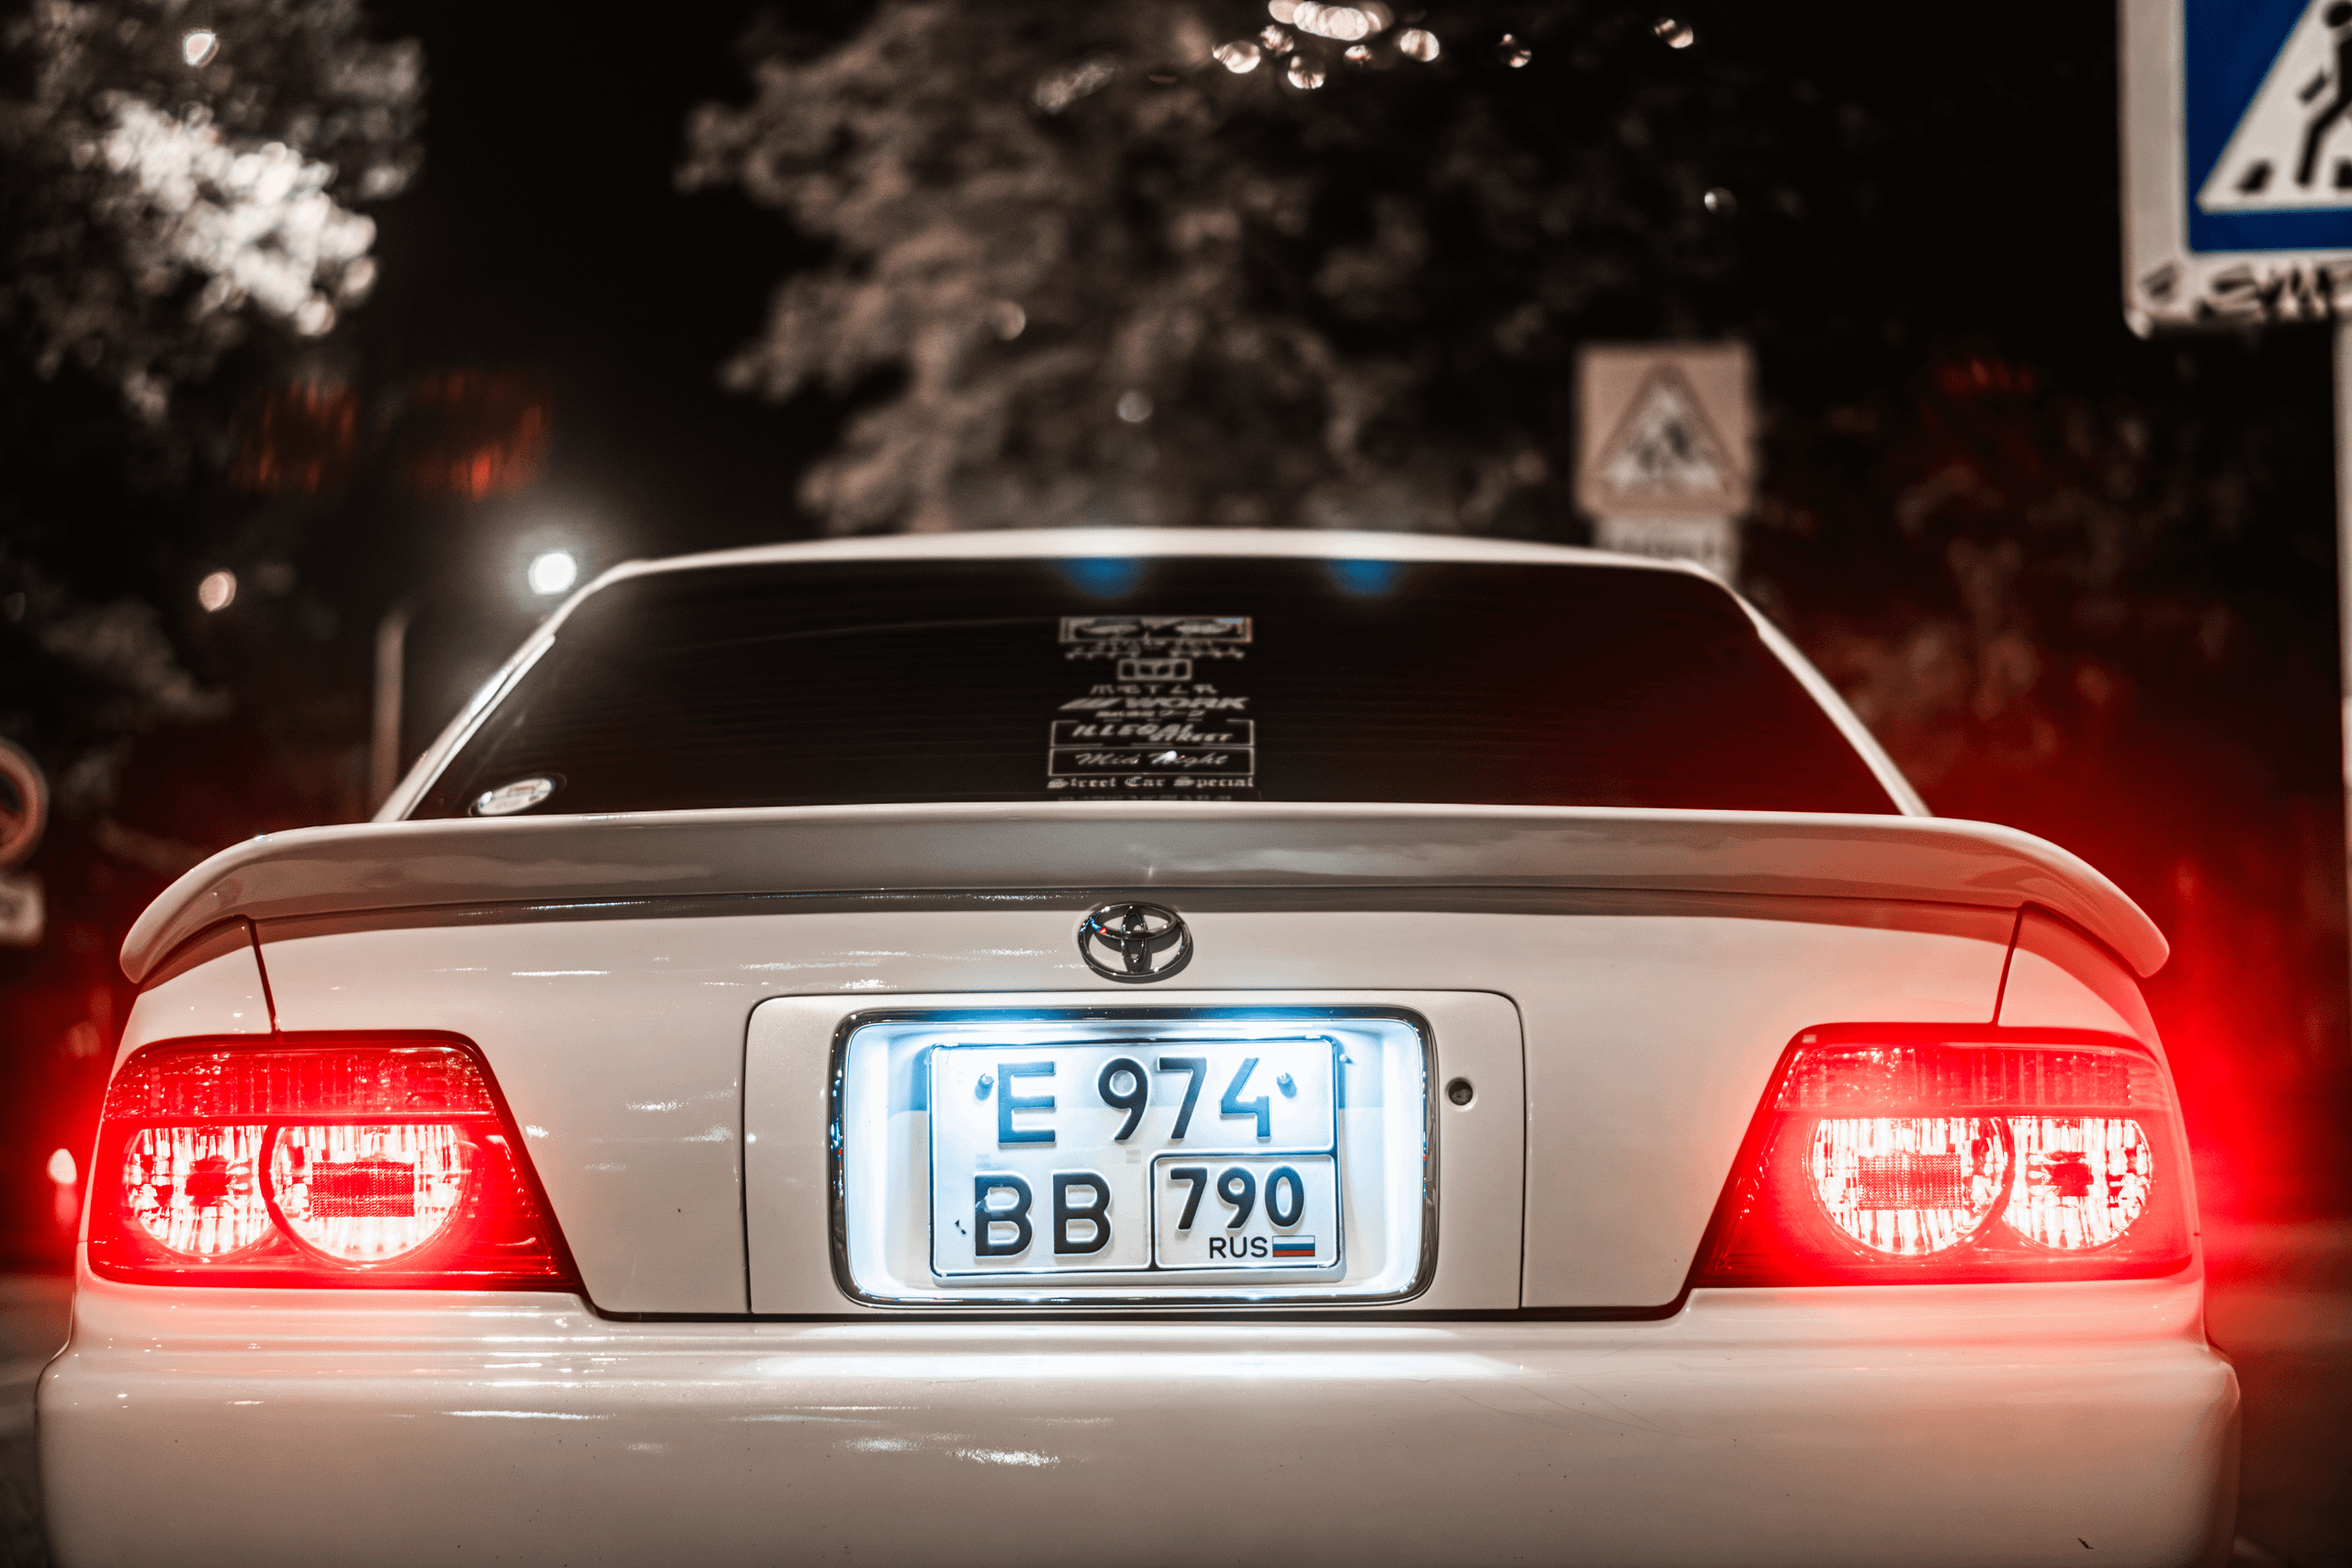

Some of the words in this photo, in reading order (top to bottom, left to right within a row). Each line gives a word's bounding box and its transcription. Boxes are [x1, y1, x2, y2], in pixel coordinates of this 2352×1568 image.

[1125, 697, 1250, 710] WORK
[1075, 752, 1141, 765] Mid
[1046, 777, 1117, 789] Street
[1124, 775, 1166, 788] Car
[1172, 777, 1255, 789] Special
[998, 1060, 1057, 1145] E
[1097, 1056, 1272, 1141] 974
[974, 1171, 1112, 1257] BB
[1170, 1166, 1306, 1230] 790
[1208, 1236, 1269, 1258] RUS
